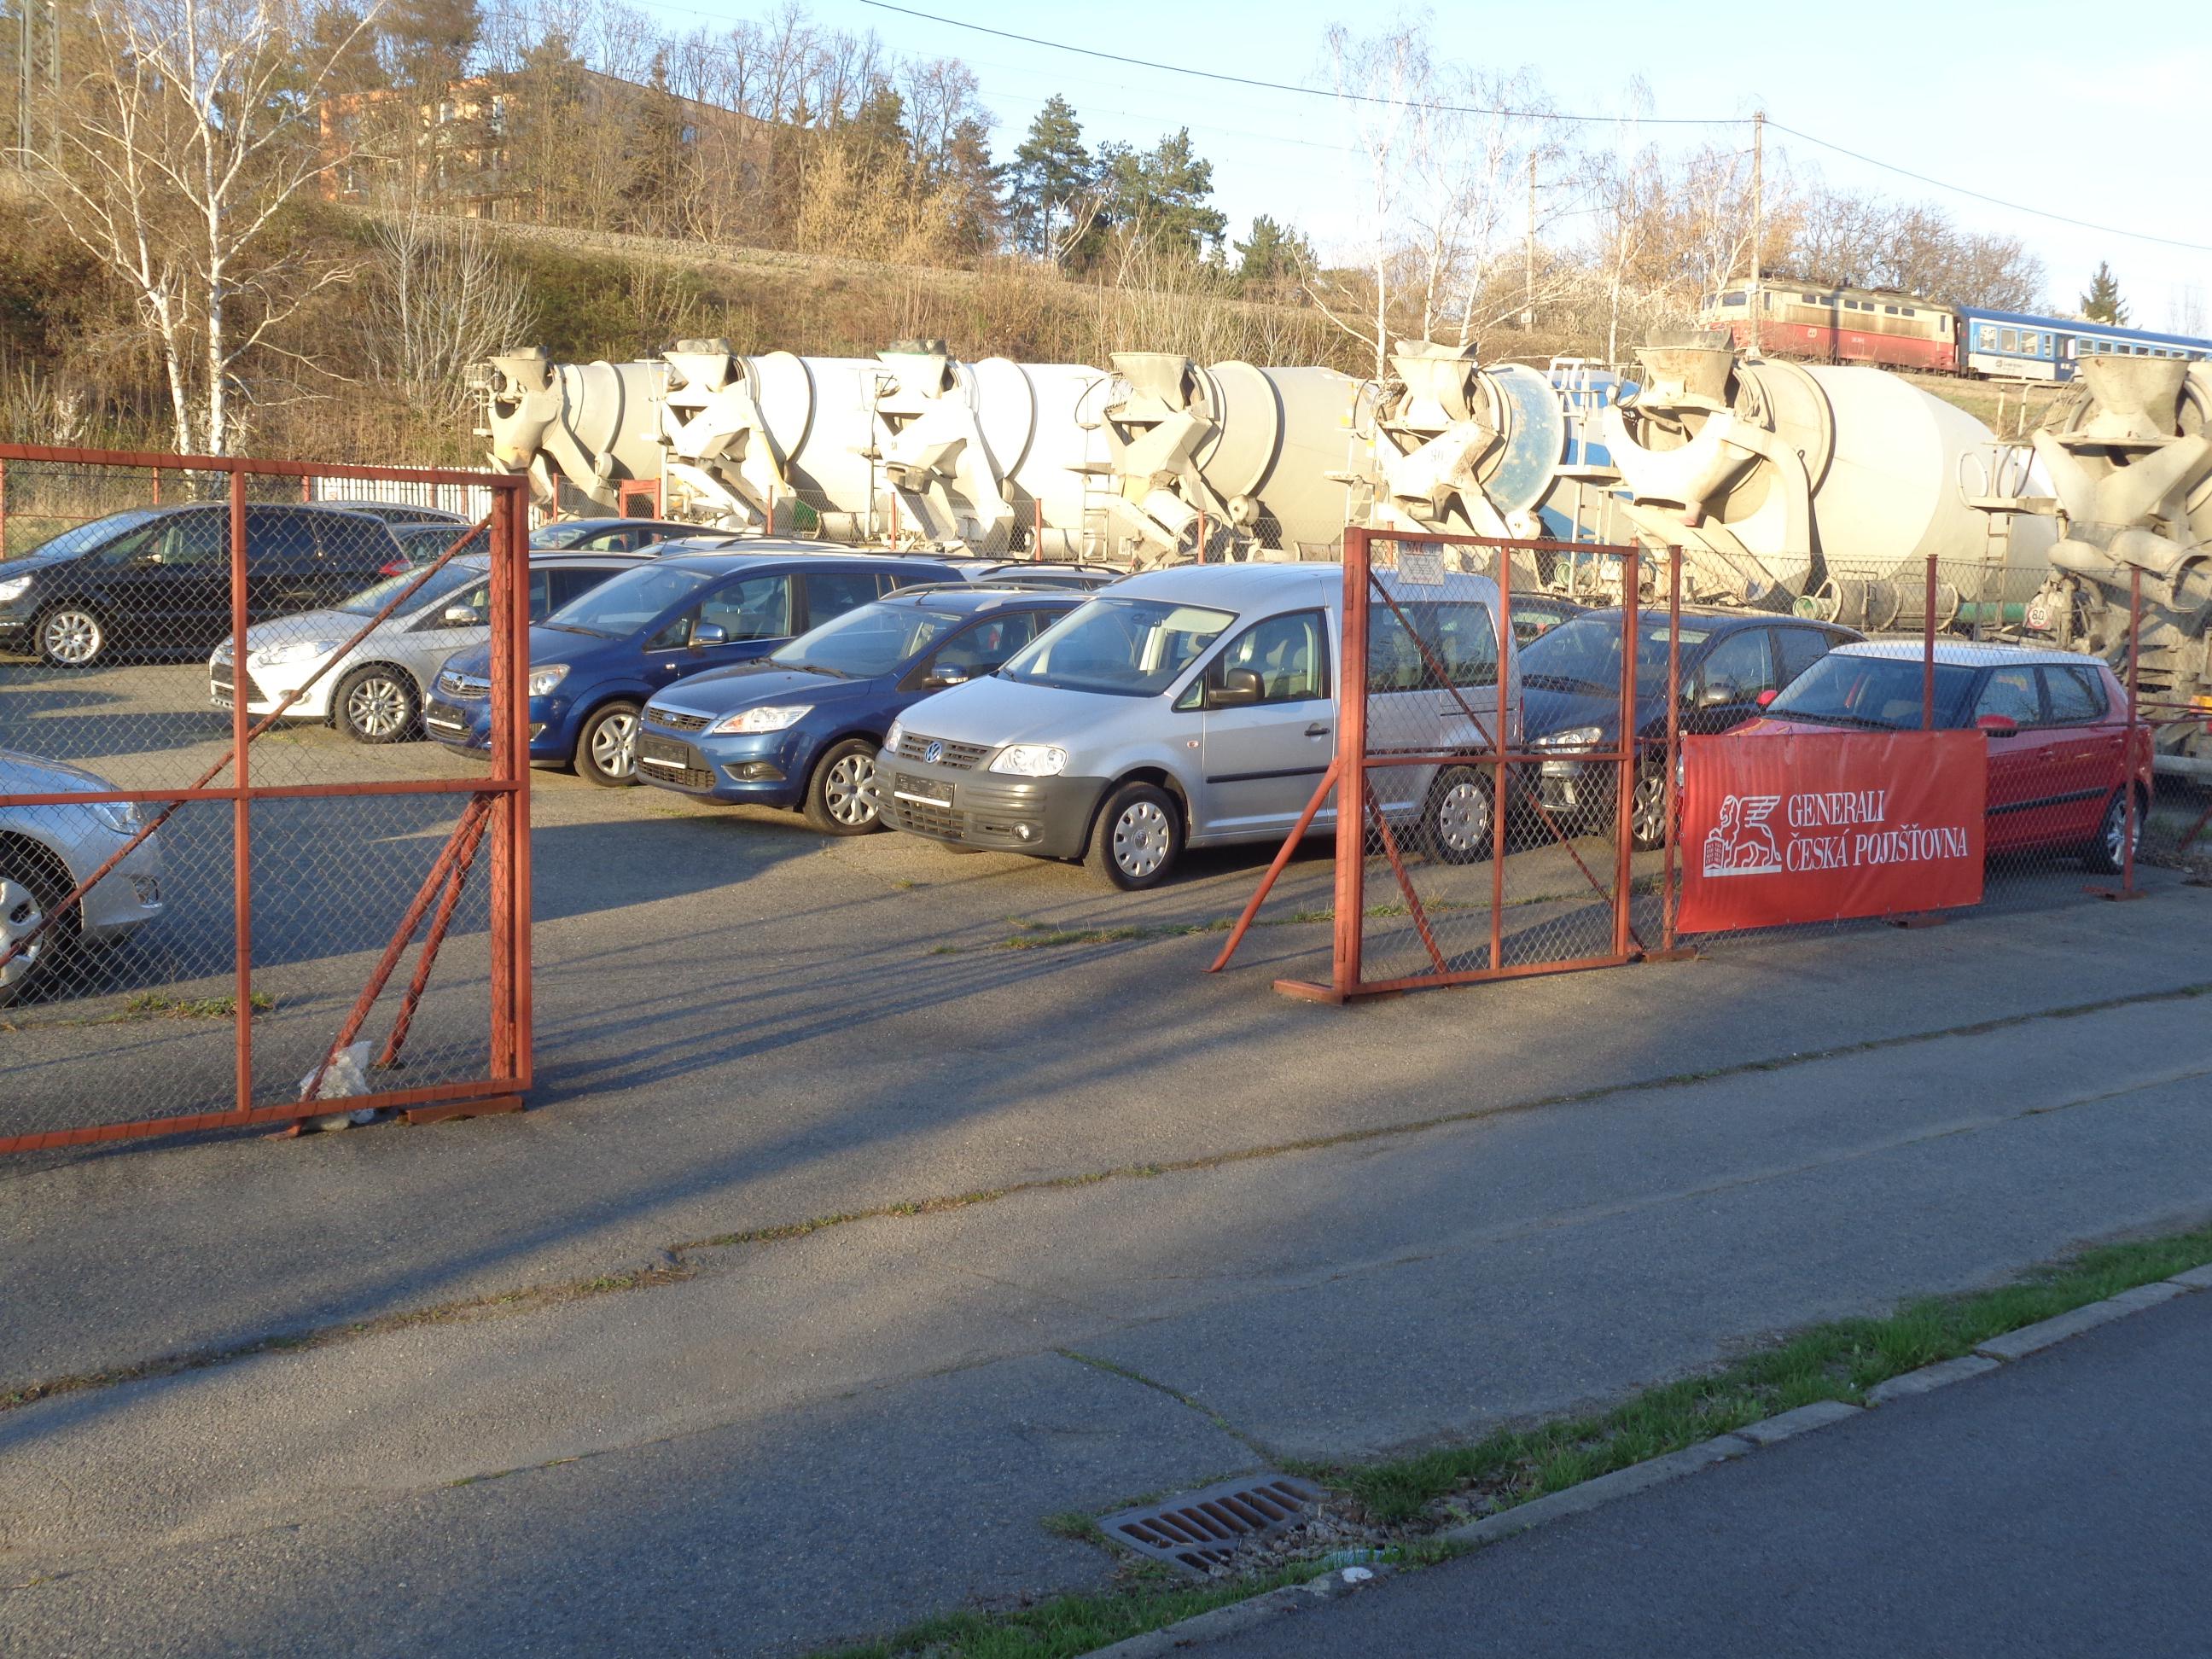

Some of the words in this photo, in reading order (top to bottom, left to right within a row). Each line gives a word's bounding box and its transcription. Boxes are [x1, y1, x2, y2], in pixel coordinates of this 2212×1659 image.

[1787, 790, 1885, 827] GENERALI
[1786, 828, 1850, 871] ČESKÁ
[1853, 823, 1968, 866] POJIŠŤOVNA
